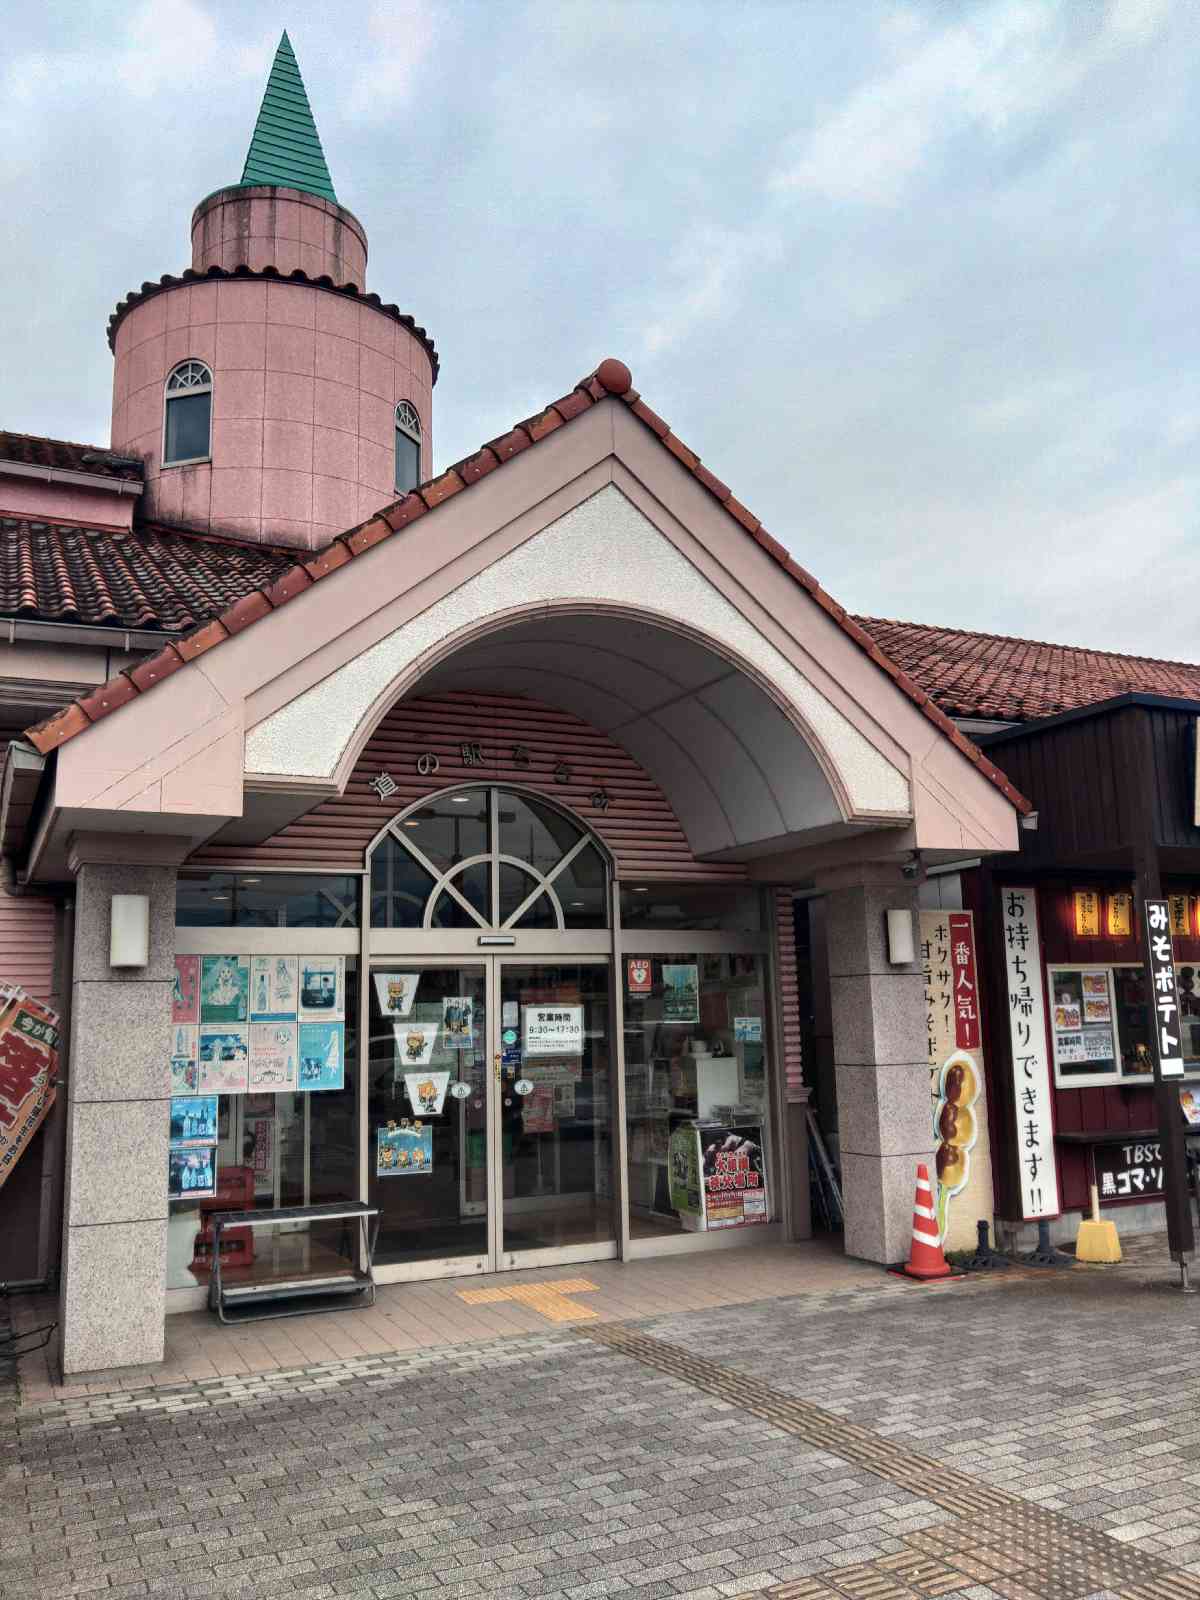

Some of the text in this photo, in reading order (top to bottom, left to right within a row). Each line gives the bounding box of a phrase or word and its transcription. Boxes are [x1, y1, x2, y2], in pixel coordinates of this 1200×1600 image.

[630, 961, 649, 969] AED
[952, 922, 976, 1046] 一番人気!
[1149, 905, 1178, 1055] みそポテト
[21, 1017, 57, 1044] 今が旬
[1006, 891, 1045, 1214] お持ち帰りできます!!
